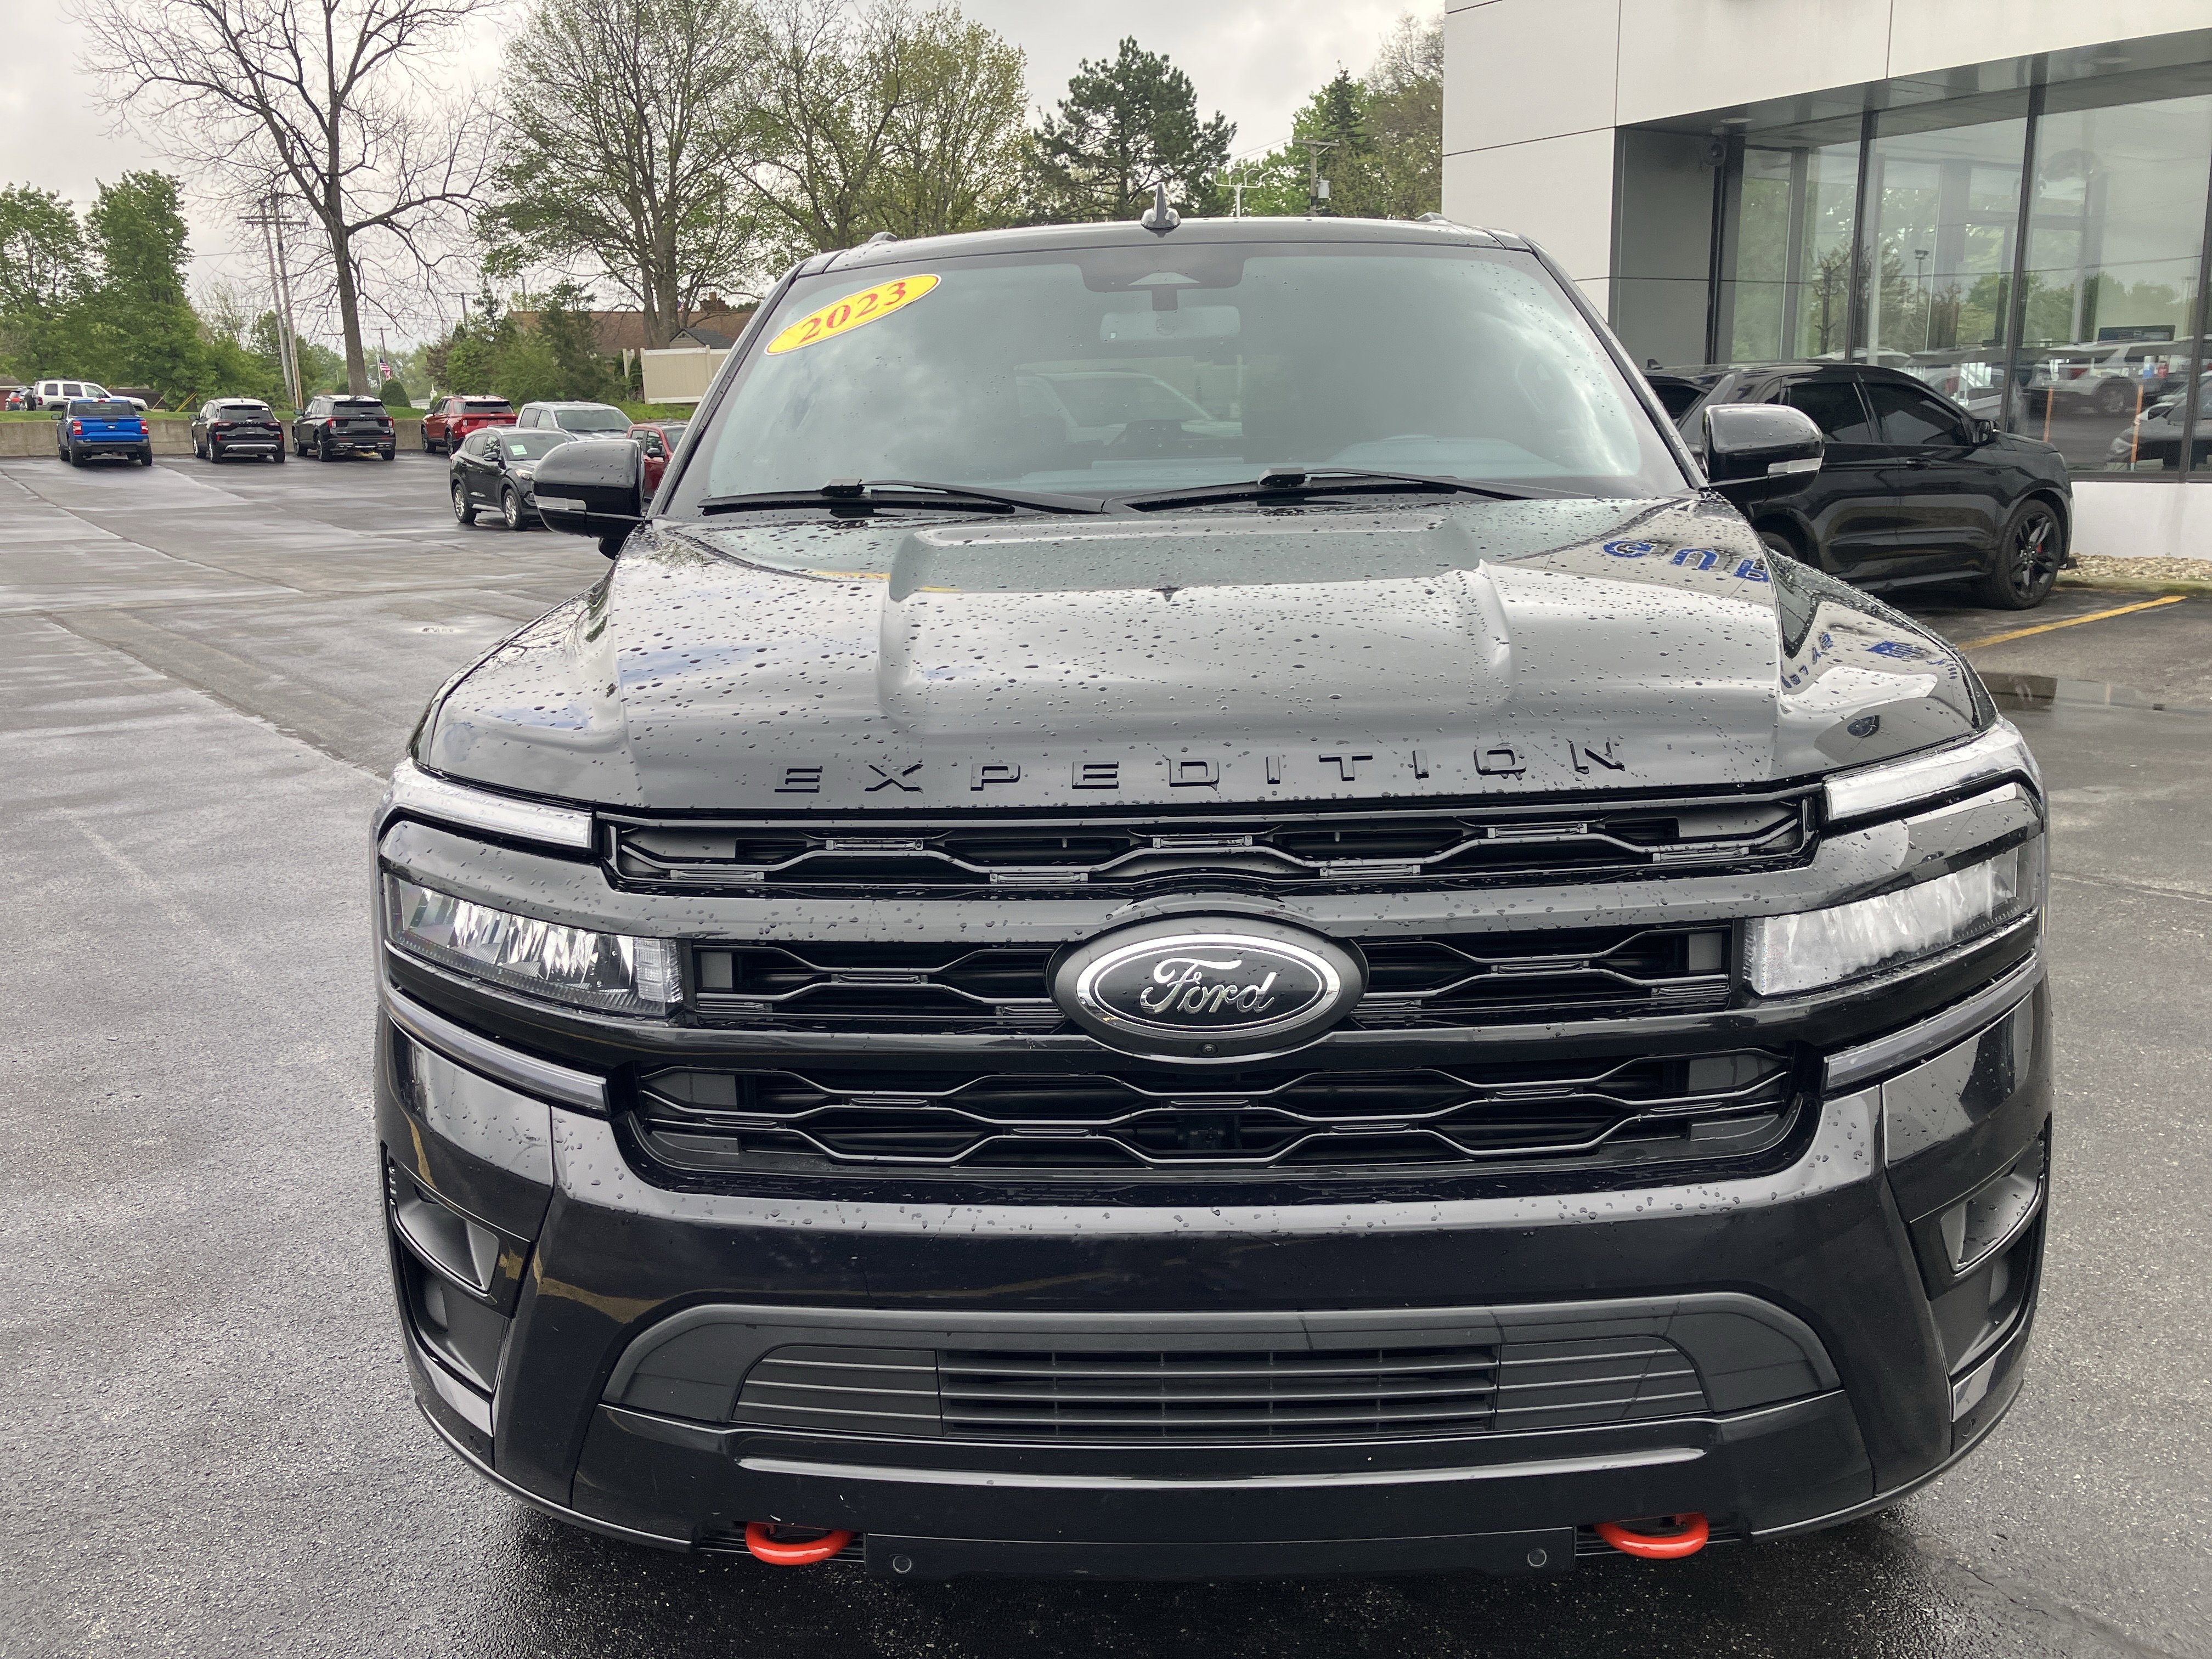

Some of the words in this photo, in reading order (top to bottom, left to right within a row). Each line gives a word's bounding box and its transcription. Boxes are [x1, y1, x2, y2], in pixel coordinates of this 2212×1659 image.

[798, 281, 906, 345] 2023
[774, 742, 1625, 793] EXPEDITION
[1139, 957, 1278, 1015] Ford
